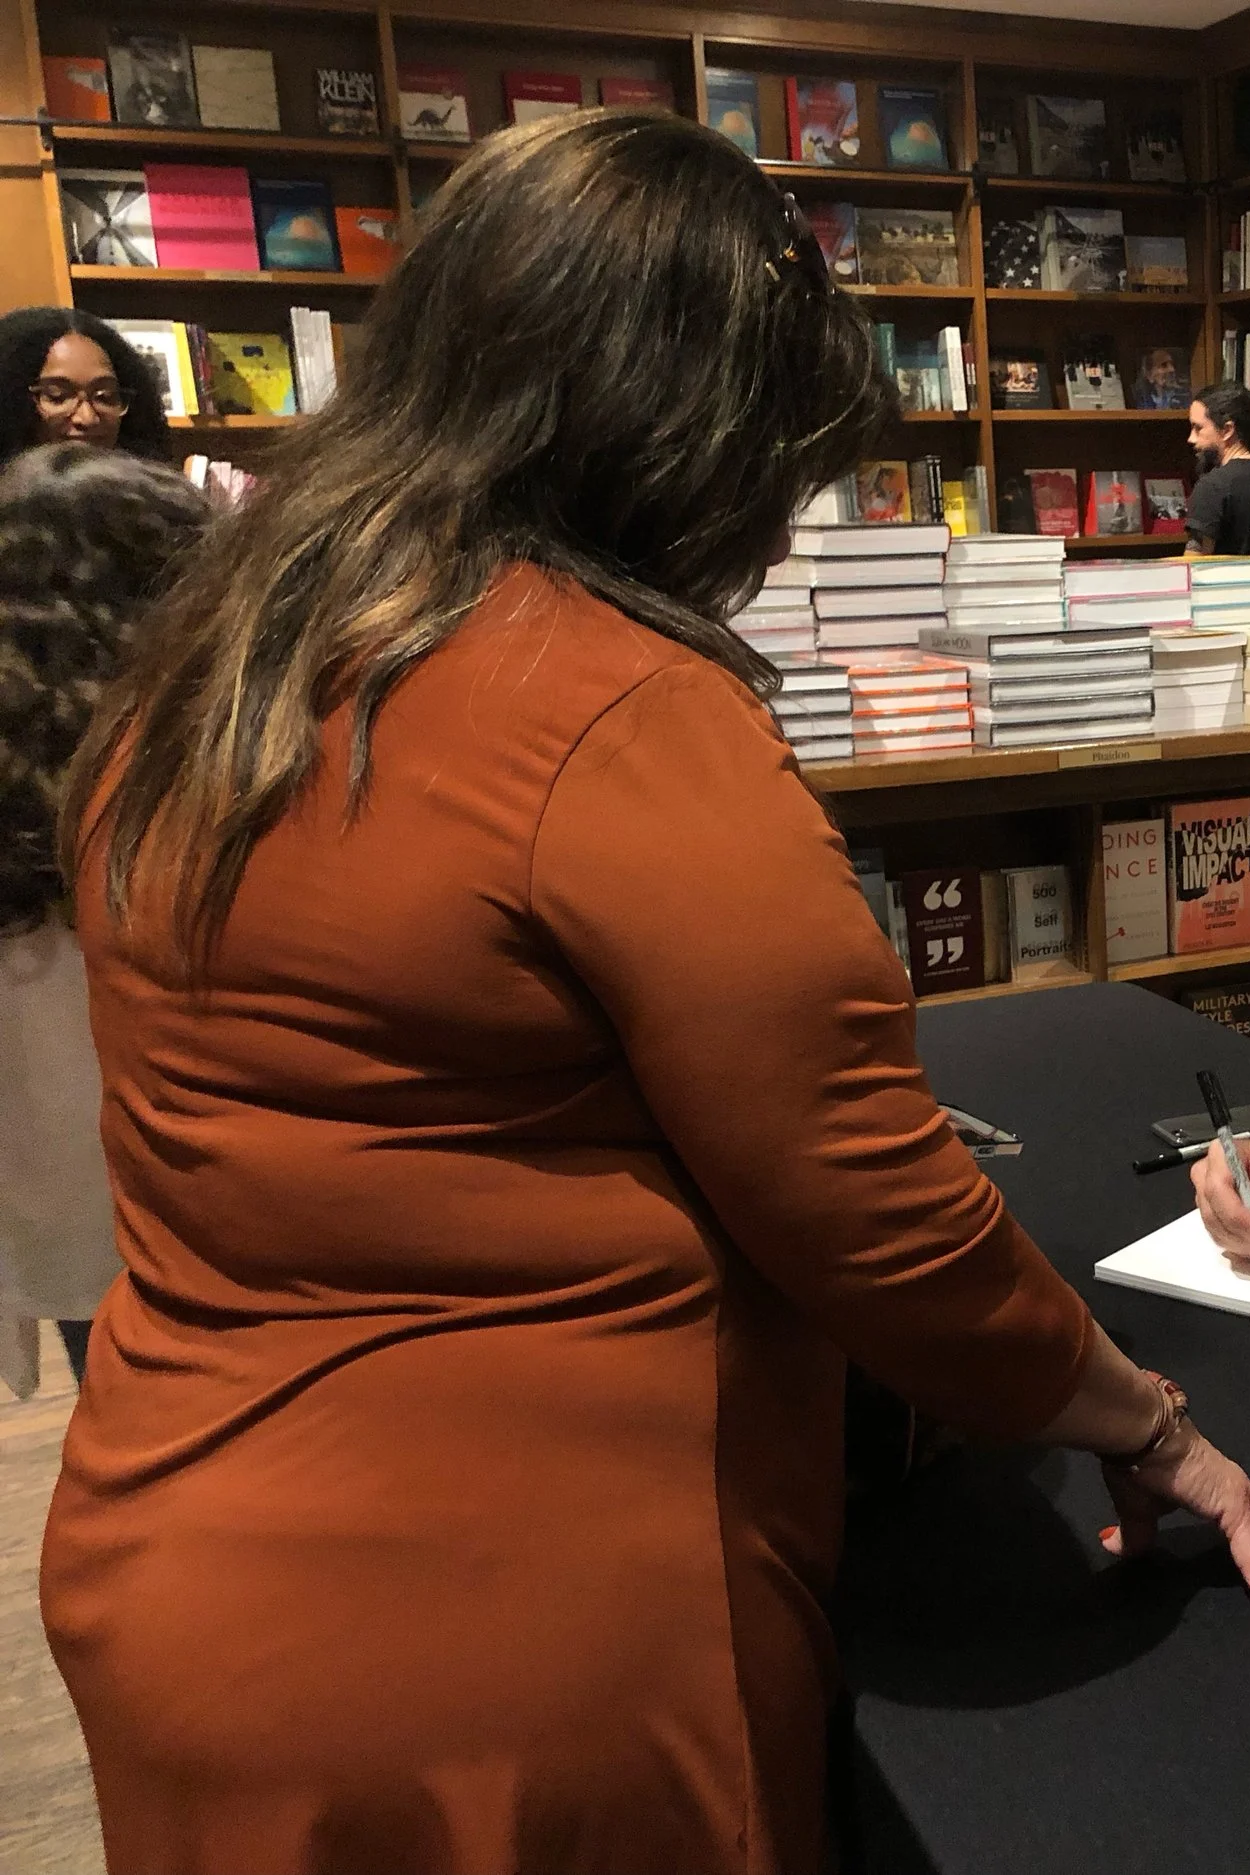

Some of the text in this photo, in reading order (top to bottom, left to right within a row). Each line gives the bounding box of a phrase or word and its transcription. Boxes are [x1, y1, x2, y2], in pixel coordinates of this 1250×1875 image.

[317, 68, 374, 84] WILLIAM
[320, 80, 376, 102] KLEIN
[1092, 750, 1131, 762] Phaidon
[1032, 885, 1057, 899] 500
[1034, 913, 1058, 928] Self
[1021, 943, 1071, 958] Portraits
[1204, 1009, 1232, 1022] YLE
